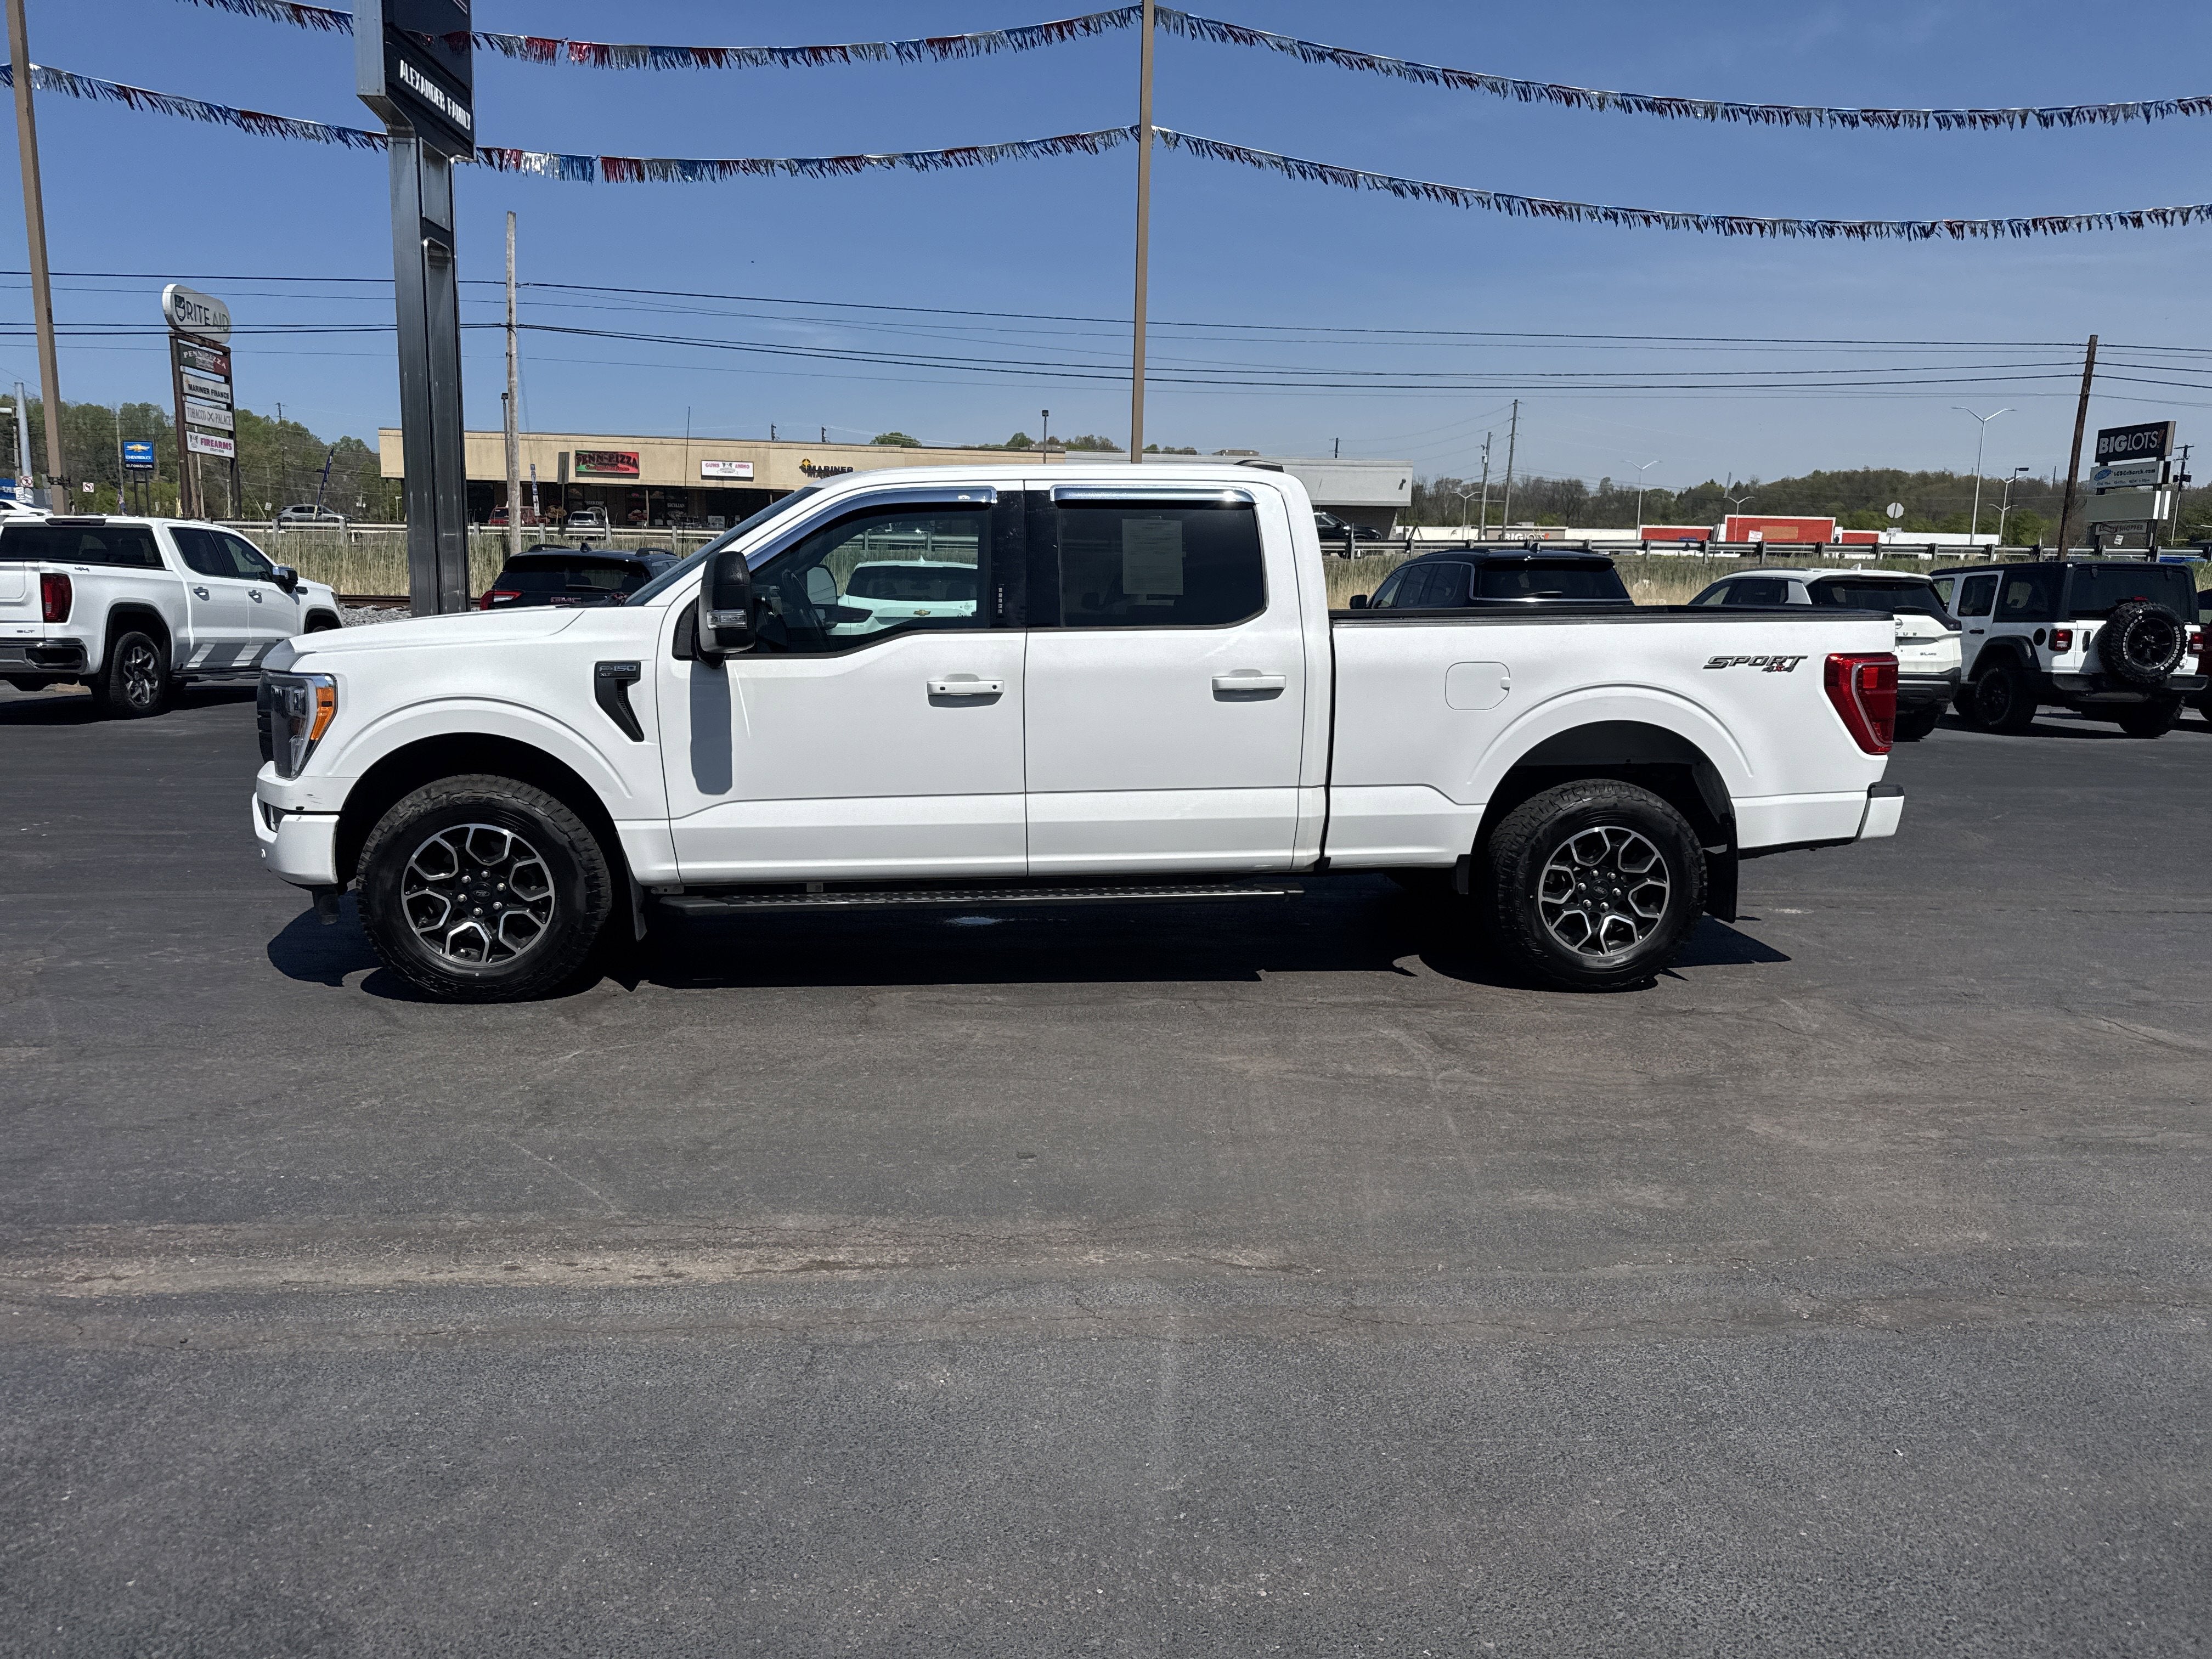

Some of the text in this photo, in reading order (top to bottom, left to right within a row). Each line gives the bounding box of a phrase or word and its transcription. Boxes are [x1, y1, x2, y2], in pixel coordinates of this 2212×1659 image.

[400, 59, 470, 131] ALEXANDER FAMILY
[186, 301, 229, 331] RITE AID
[188, 383, 229, 399] MARINER FINANCE
[187, 407, 232, 426] TOBACCO PALACE
[200, 438, 232, 450] FIREARMS
[1702, 656, 1808, 669] SPORT
